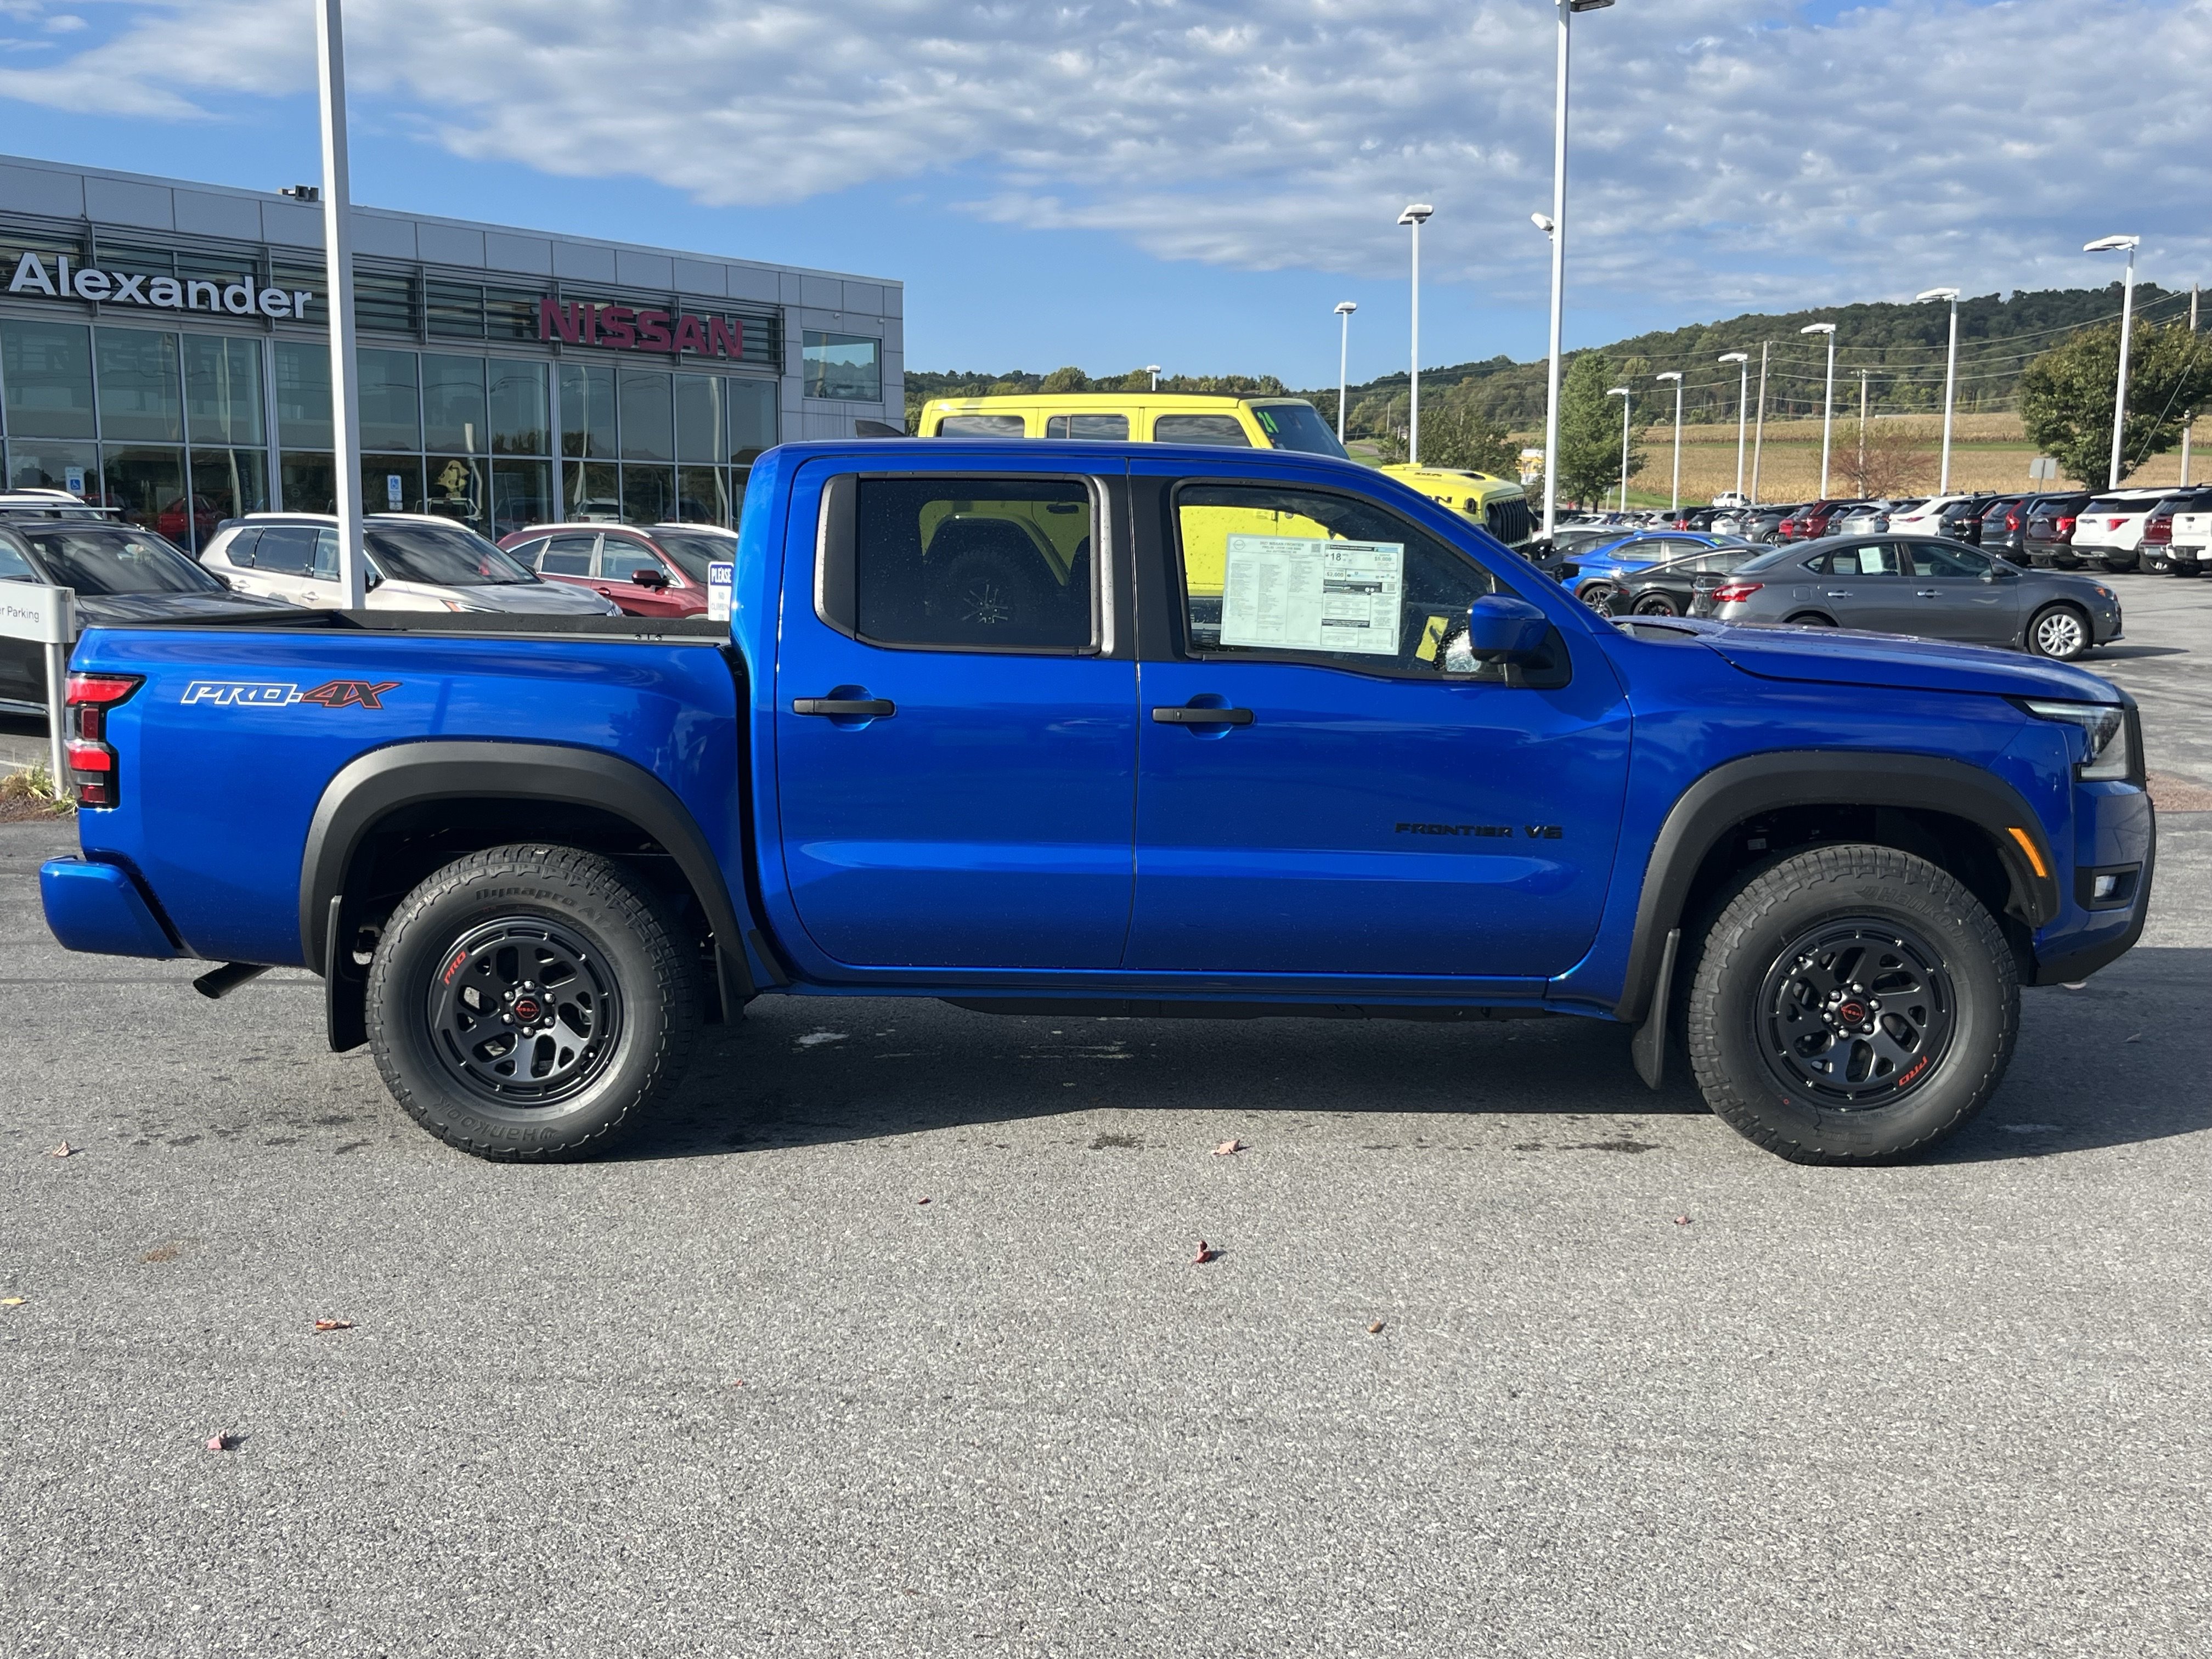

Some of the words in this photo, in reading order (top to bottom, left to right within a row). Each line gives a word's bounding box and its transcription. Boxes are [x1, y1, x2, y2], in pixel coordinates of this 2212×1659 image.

[8, 252, 313, 319] Alexander
[539, 298, 743, 359] NISSAN
[1330, 552, 1341, 561] 18
[710, 567, 732, 584] PLEASE
[7, 606, 39, 623] Parking
[1394, 822, 1514, 838] FRONTIER
[1523, 825, 1564, 840] V6
[476, 887, 578, 907] Dynapro
[1876, 886, 1972, 952] Hankook
[444, 950, 466, 986] PRO
[1898, 1055, 1928, 1087] PRO
[433, 1096, 538, 1142] Hankook
